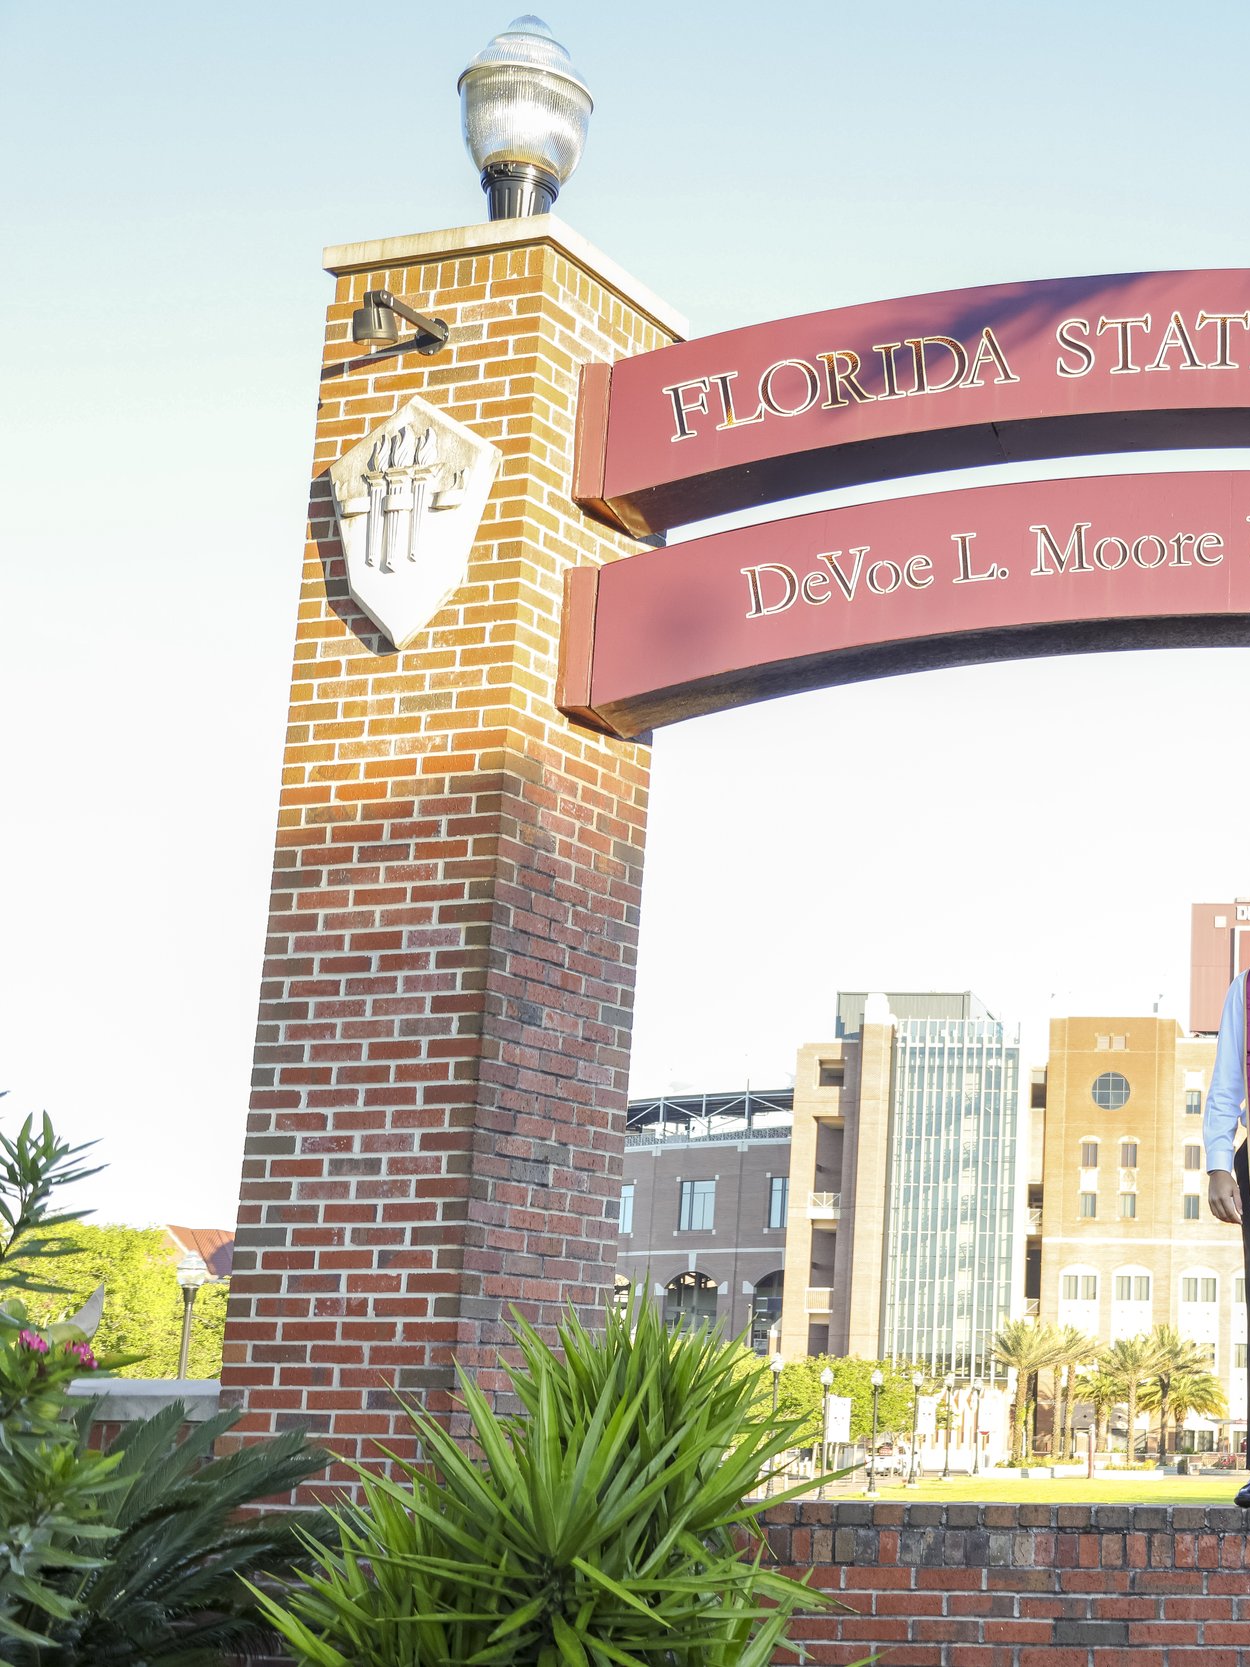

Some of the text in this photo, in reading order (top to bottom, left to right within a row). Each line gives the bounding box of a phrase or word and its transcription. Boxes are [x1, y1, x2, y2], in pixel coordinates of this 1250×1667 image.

[662, 327, 1020, 442] FLORIDA
[740, 546, 934, 619] DeVoe
[951, 531, 1009, 584] L.
[1029, 522, 1224, 576] Moore
